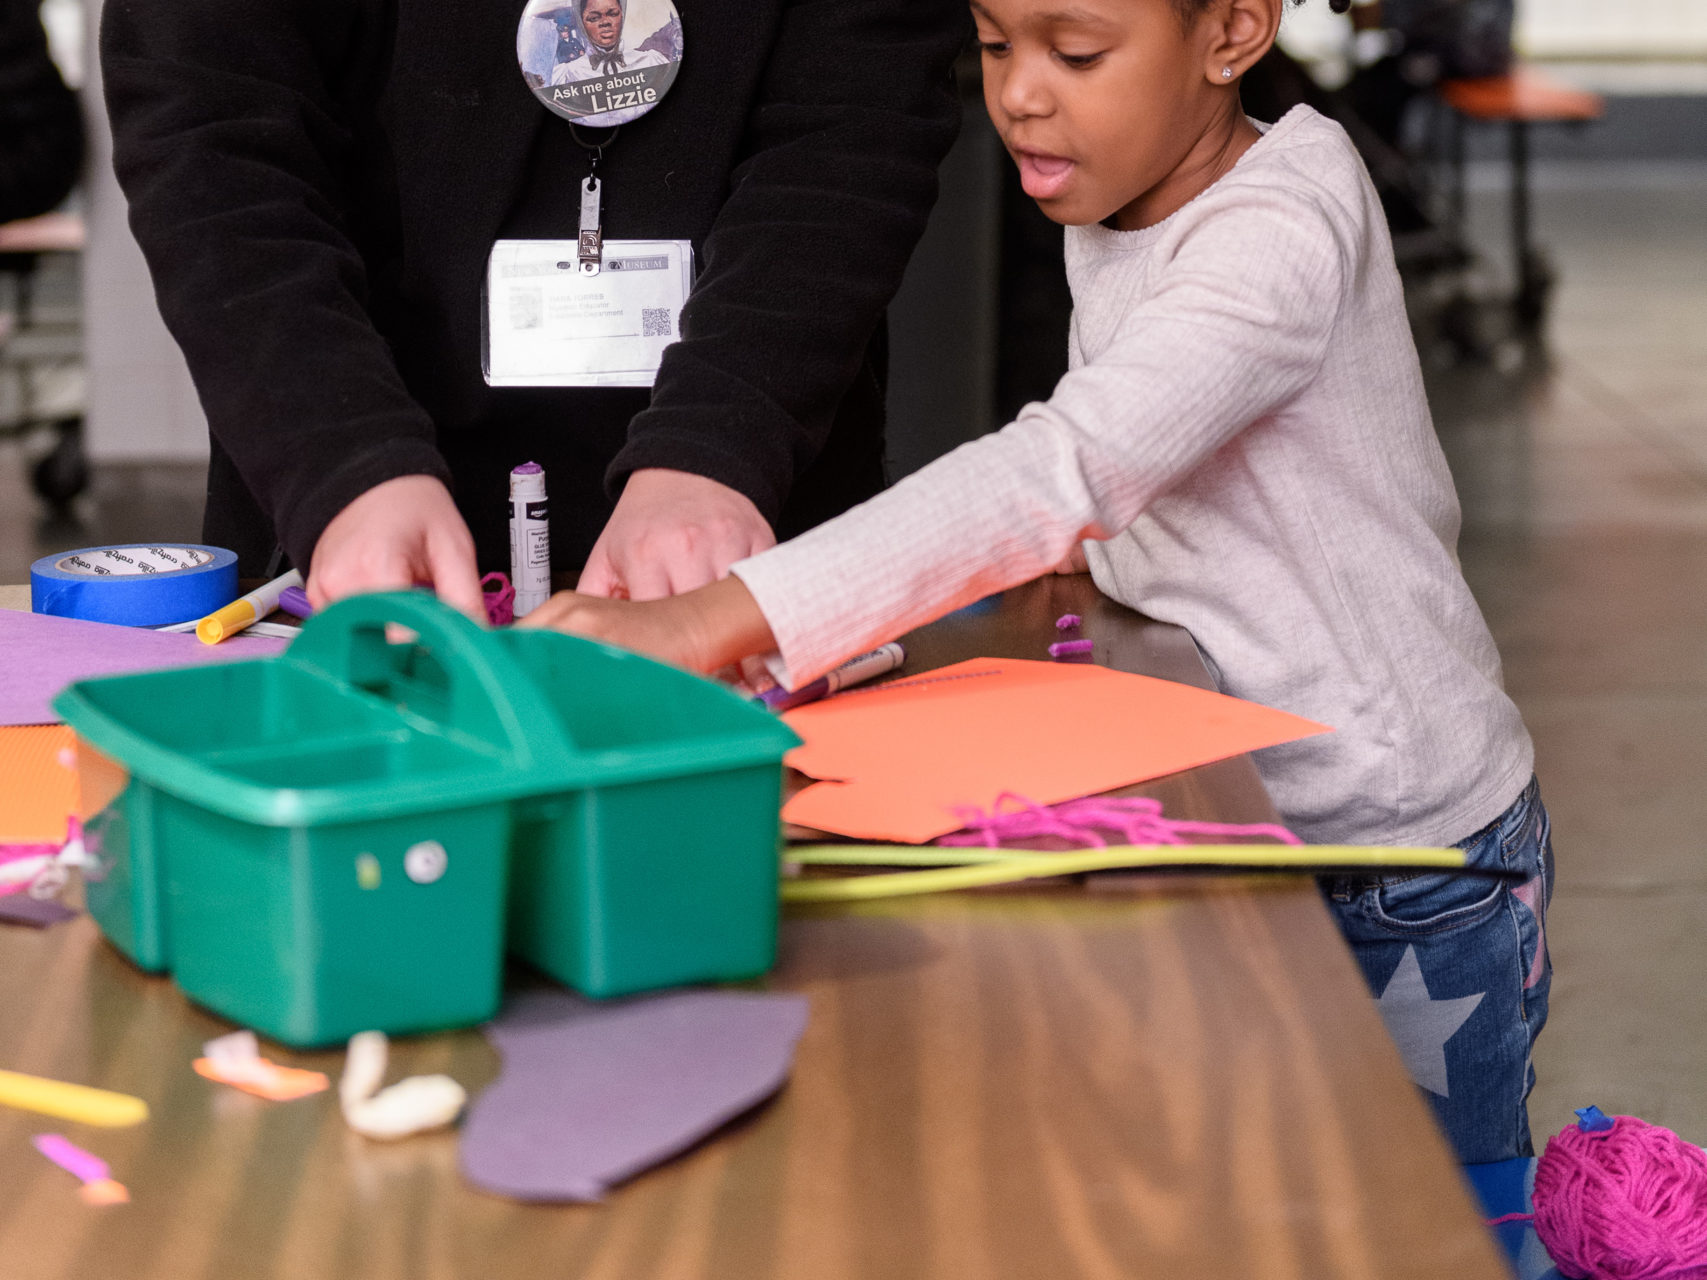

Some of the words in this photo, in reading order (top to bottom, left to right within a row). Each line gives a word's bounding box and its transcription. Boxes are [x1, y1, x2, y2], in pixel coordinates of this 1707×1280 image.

[553, 85, 579, 100] Ask
[582, 82, 602, 94] me
[606, 71, 646, 90] about
[591, 86, 657, 114] Lizzie
[103, 550, 134, 564] craftzill
[147, 547, 178, 564] craftzill
